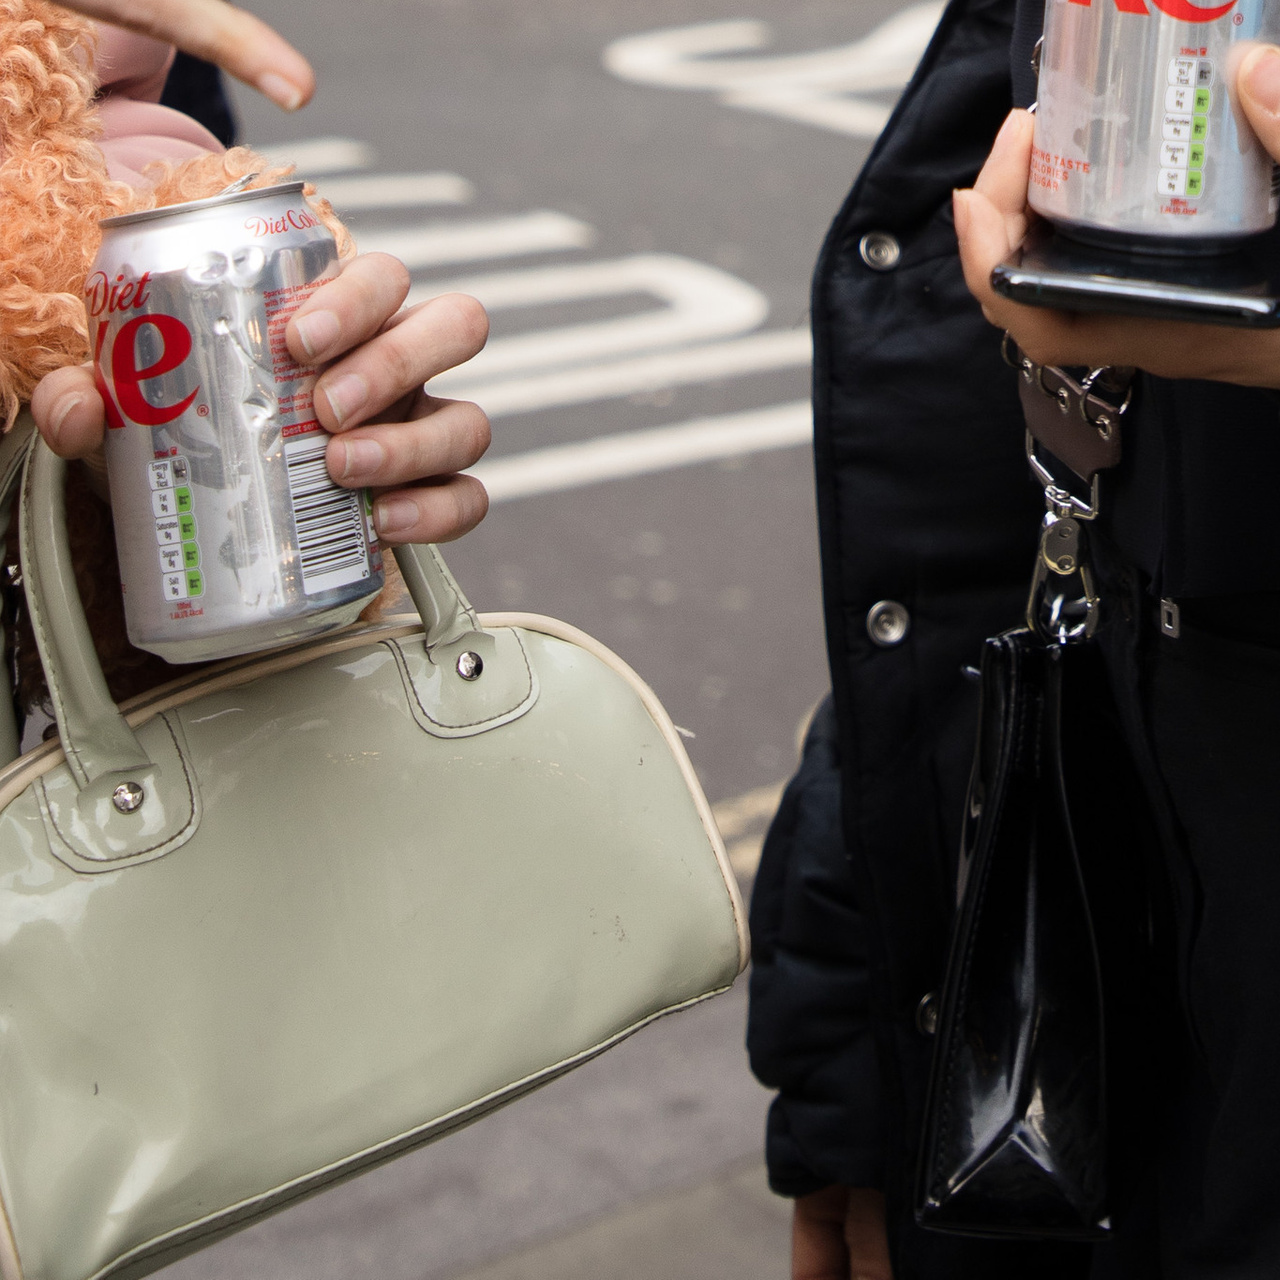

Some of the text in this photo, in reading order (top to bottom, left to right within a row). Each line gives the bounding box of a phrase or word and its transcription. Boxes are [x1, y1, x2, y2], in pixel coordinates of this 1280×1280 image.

[1054, 155, 1091, 174] TASTE
[244, 216, 288, 237] Diet
[85, 271, 152, 317] Diet
[263, 286, 292, 299] Sparkling
[293, 284, 304, 292] Low
[265, 299, 278, 308] with
[280, 296, 295, 304] Plant
[282, 425, 302, 437] best
[159, 493, 168, 502] Fat
